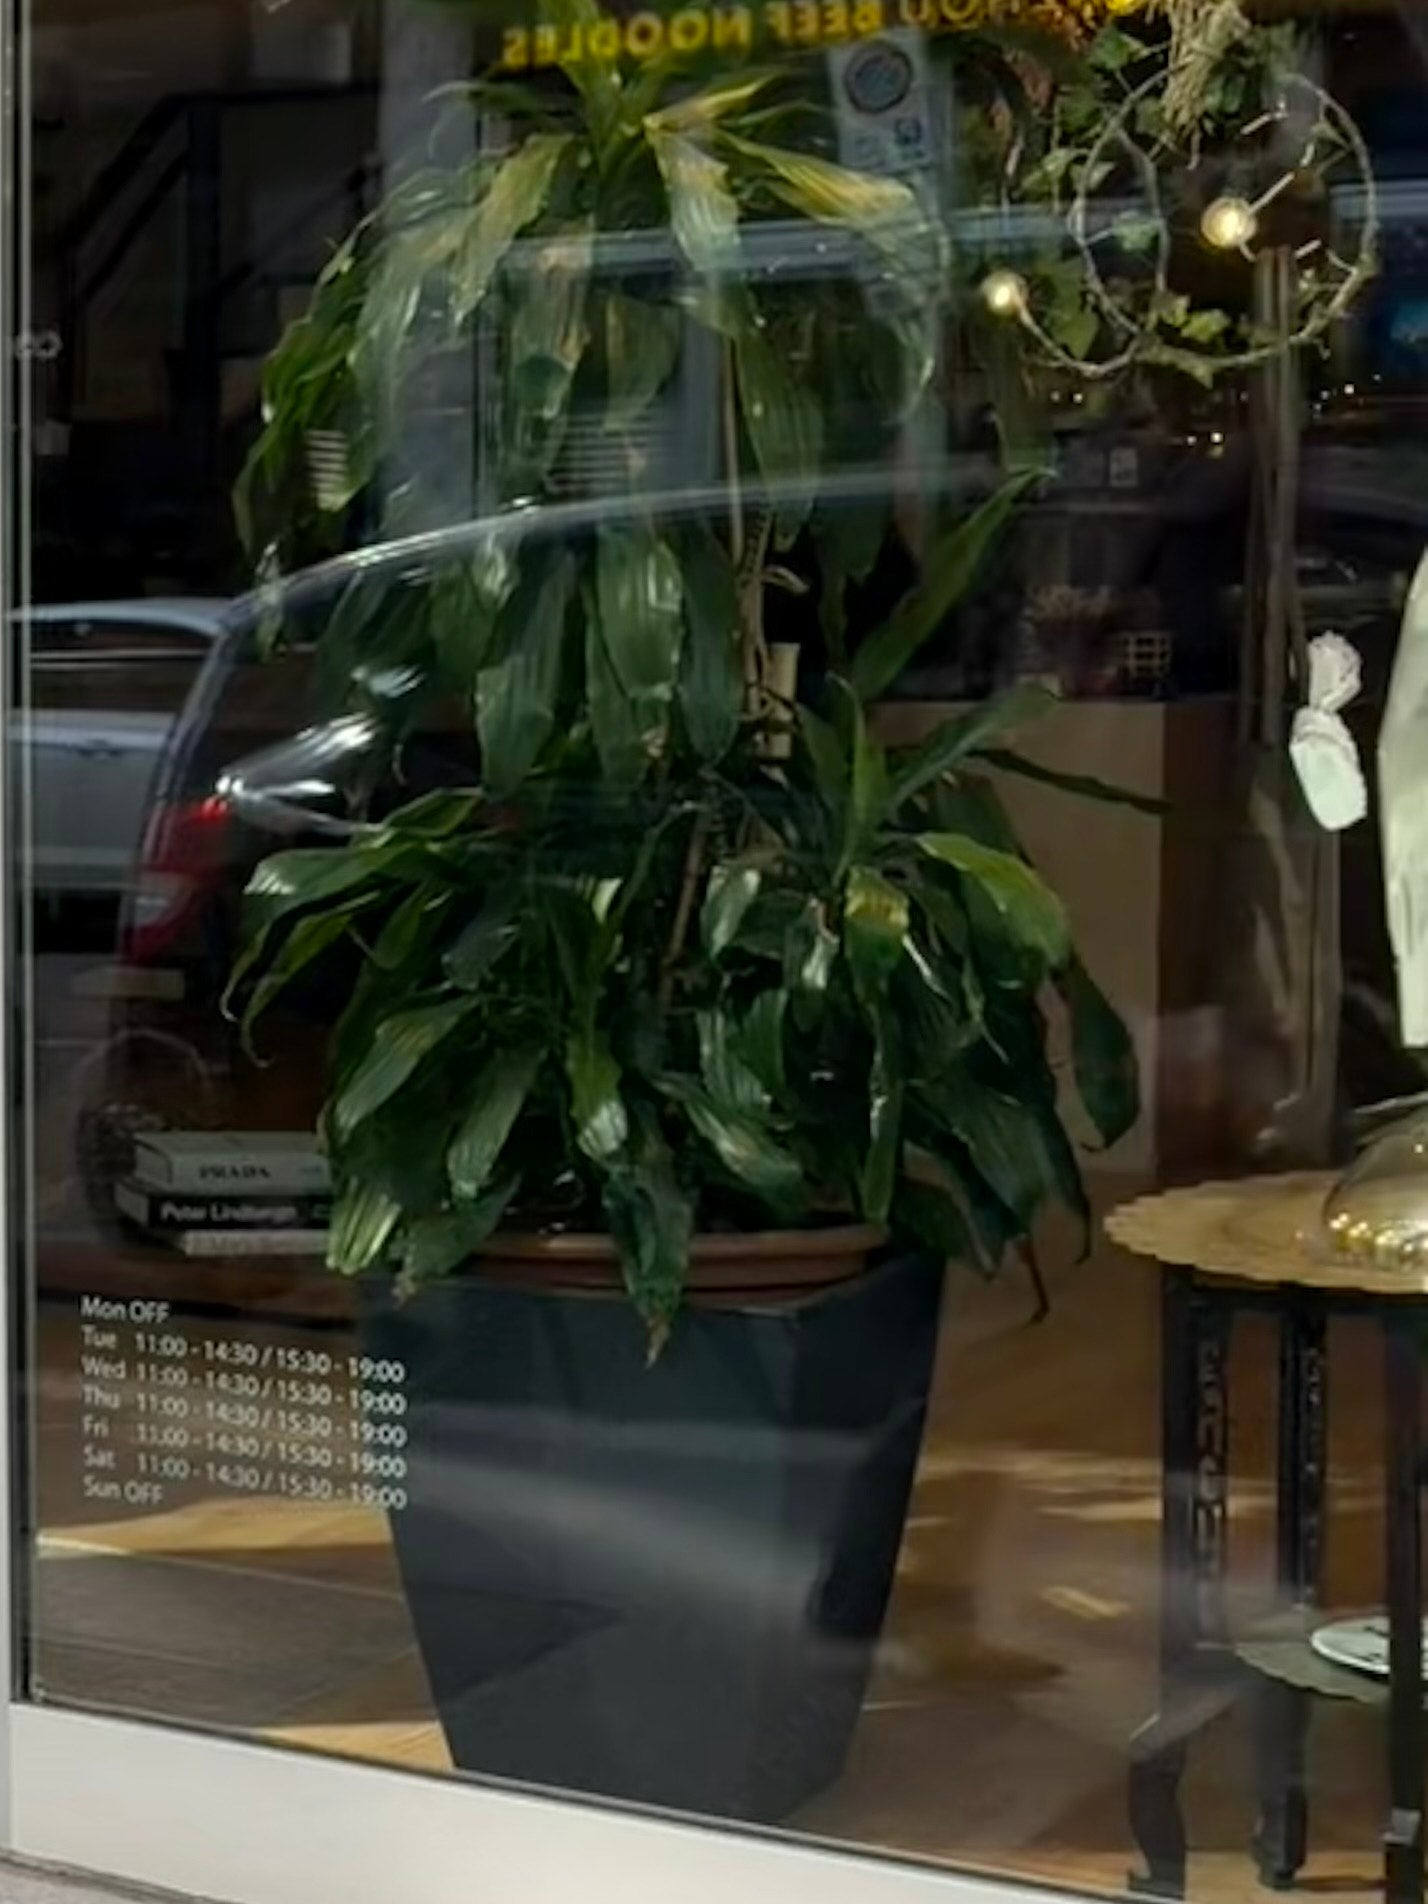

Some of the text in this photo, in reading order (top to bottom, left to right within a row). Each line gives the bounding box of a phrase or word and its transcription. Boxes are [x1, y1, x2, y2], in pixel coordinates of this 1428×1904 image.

[80, 1295, 170, 1324] Mon OFF
[81, 1324, 118, 1350] Tue
[81, 1355, 127, 1380] Wed
[82, 1383, 121, 1410] Thu
[82, 1414, 110, 1438] Fri
[83, 1445, 116, 1470] Sat
[84, 1475, 163, 1505] Sun OFF
